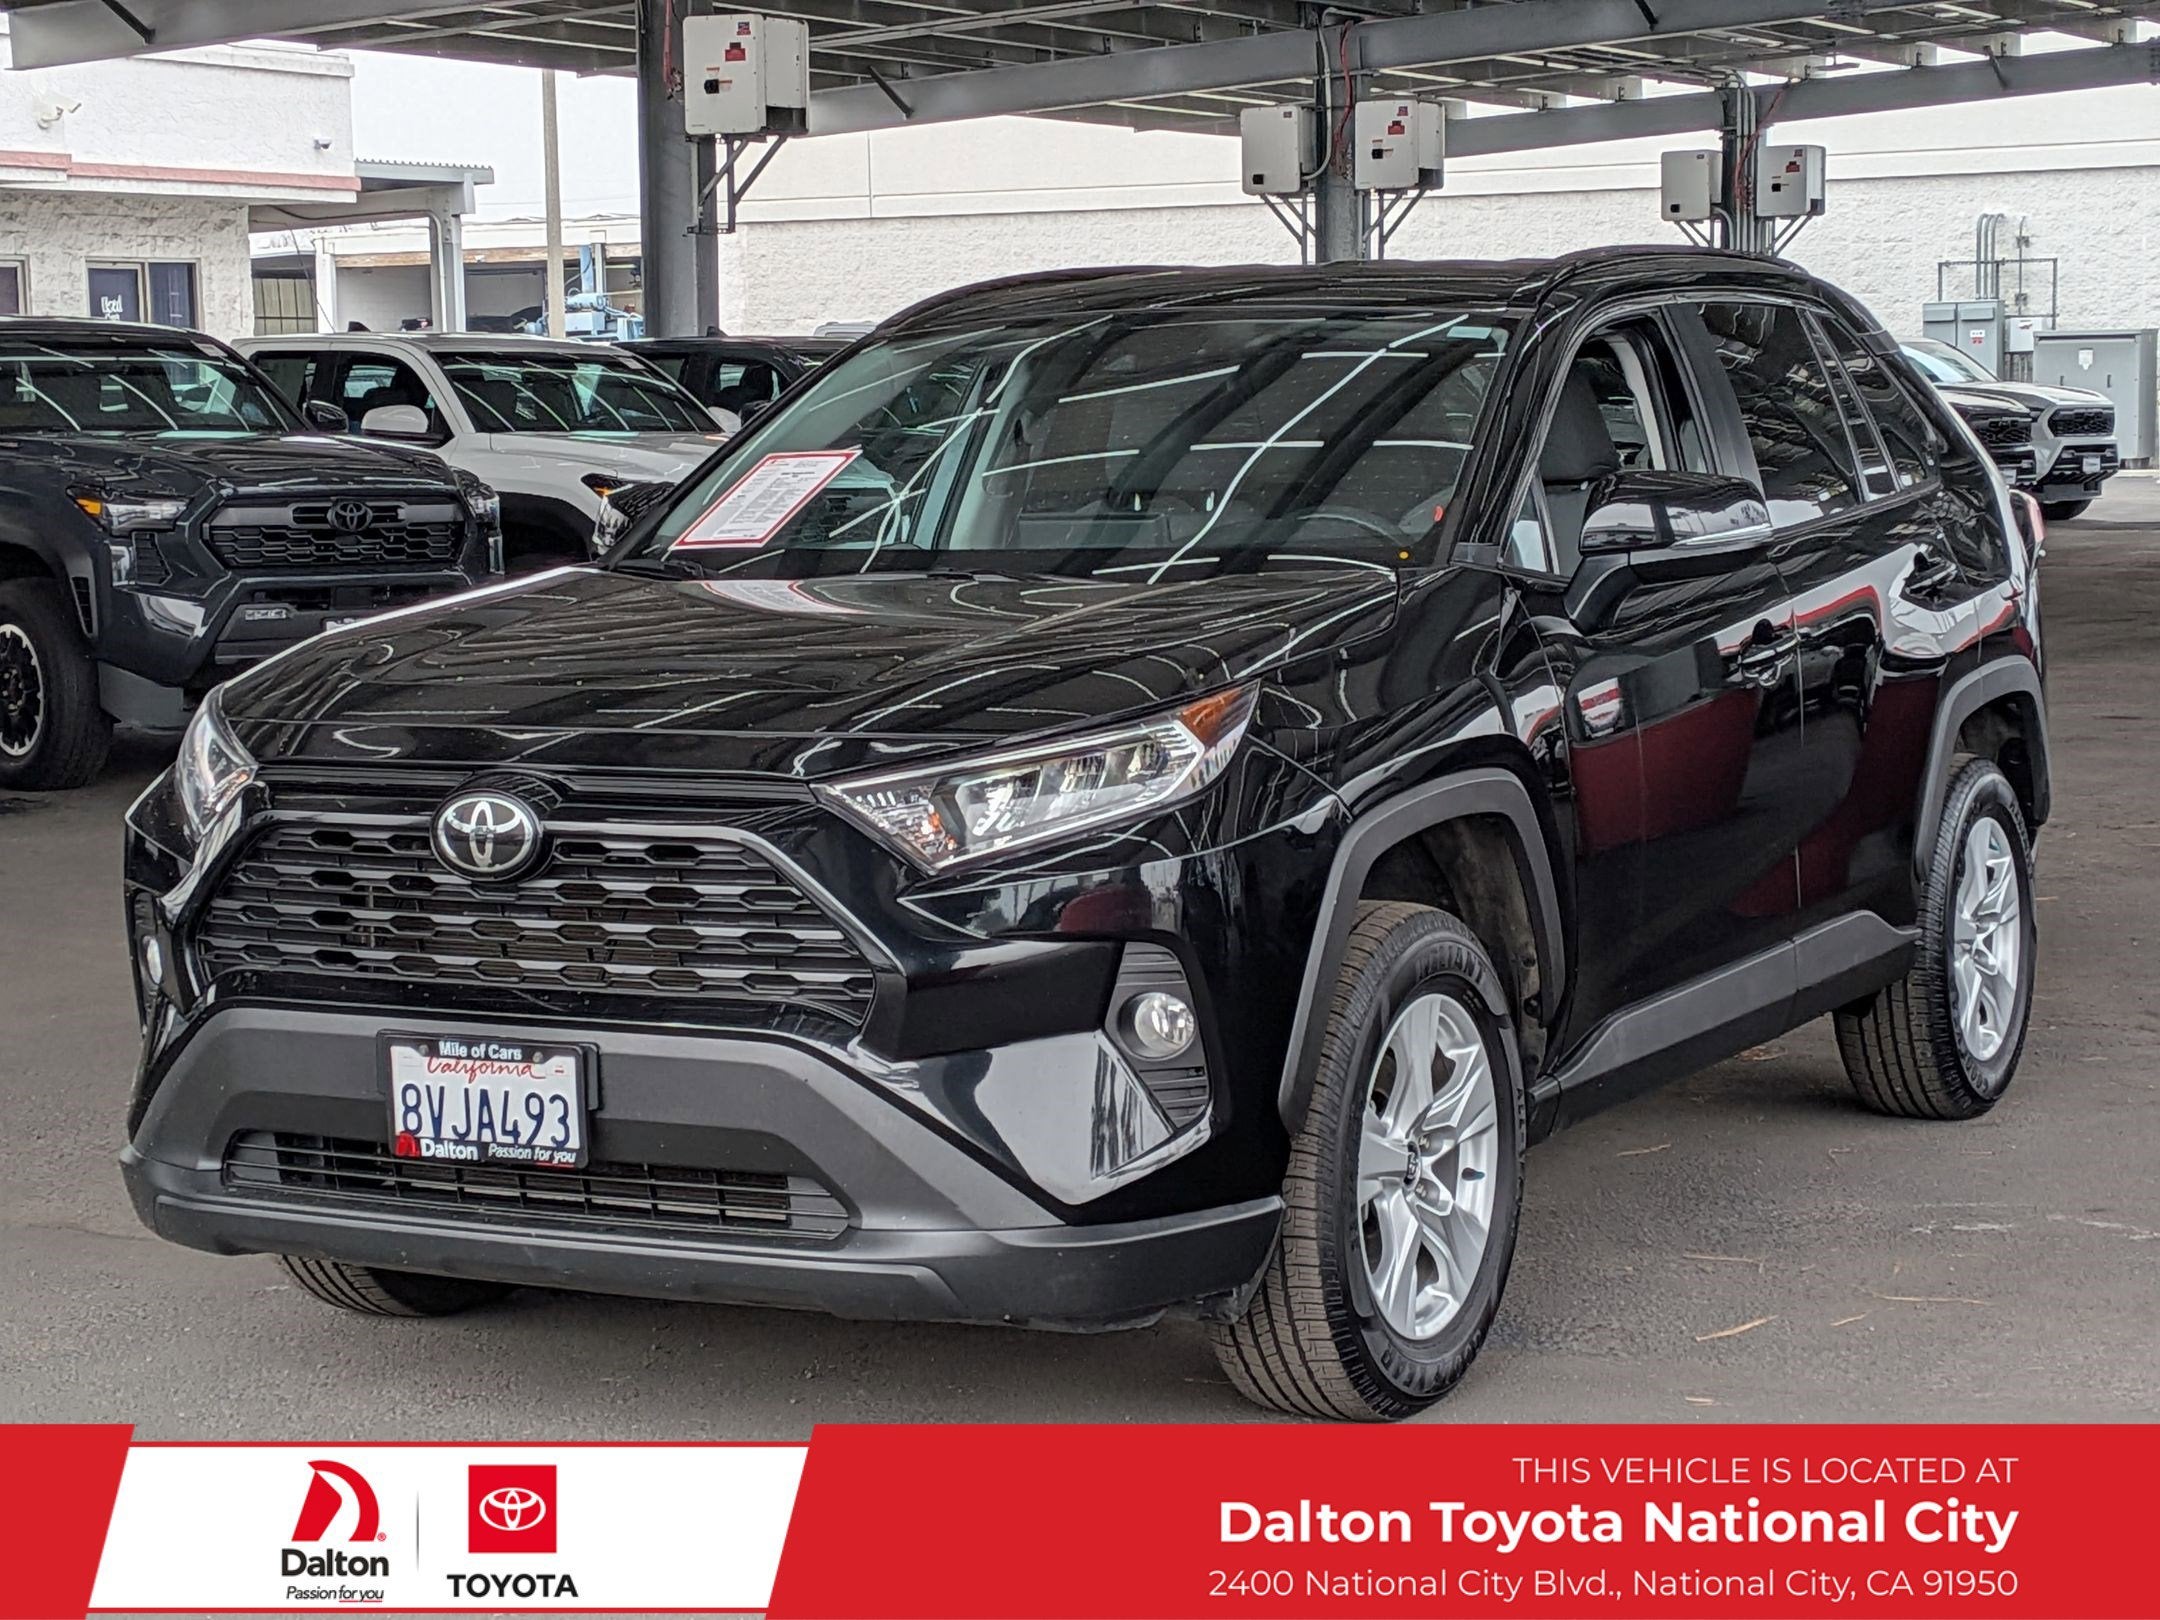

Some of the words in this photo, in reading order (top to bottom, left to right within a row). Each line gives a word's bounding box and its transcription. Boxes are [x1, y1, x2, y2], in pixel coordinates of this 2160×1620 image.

[439, 1041, 467, 1057] Mile
[471, 1043, 486, 1058] of
[489, 1045, 522, 1060] Cars
[427, 1056, 546, 1083] California
[401, 1083, 570, 1148] 8VJA493
[421, 1139, 478, 1160] Dalton
[488, 1144, 531, 1160] Passion
[533, 1145, 552, 1160] for
[552, 1149, 576, 1164] you
